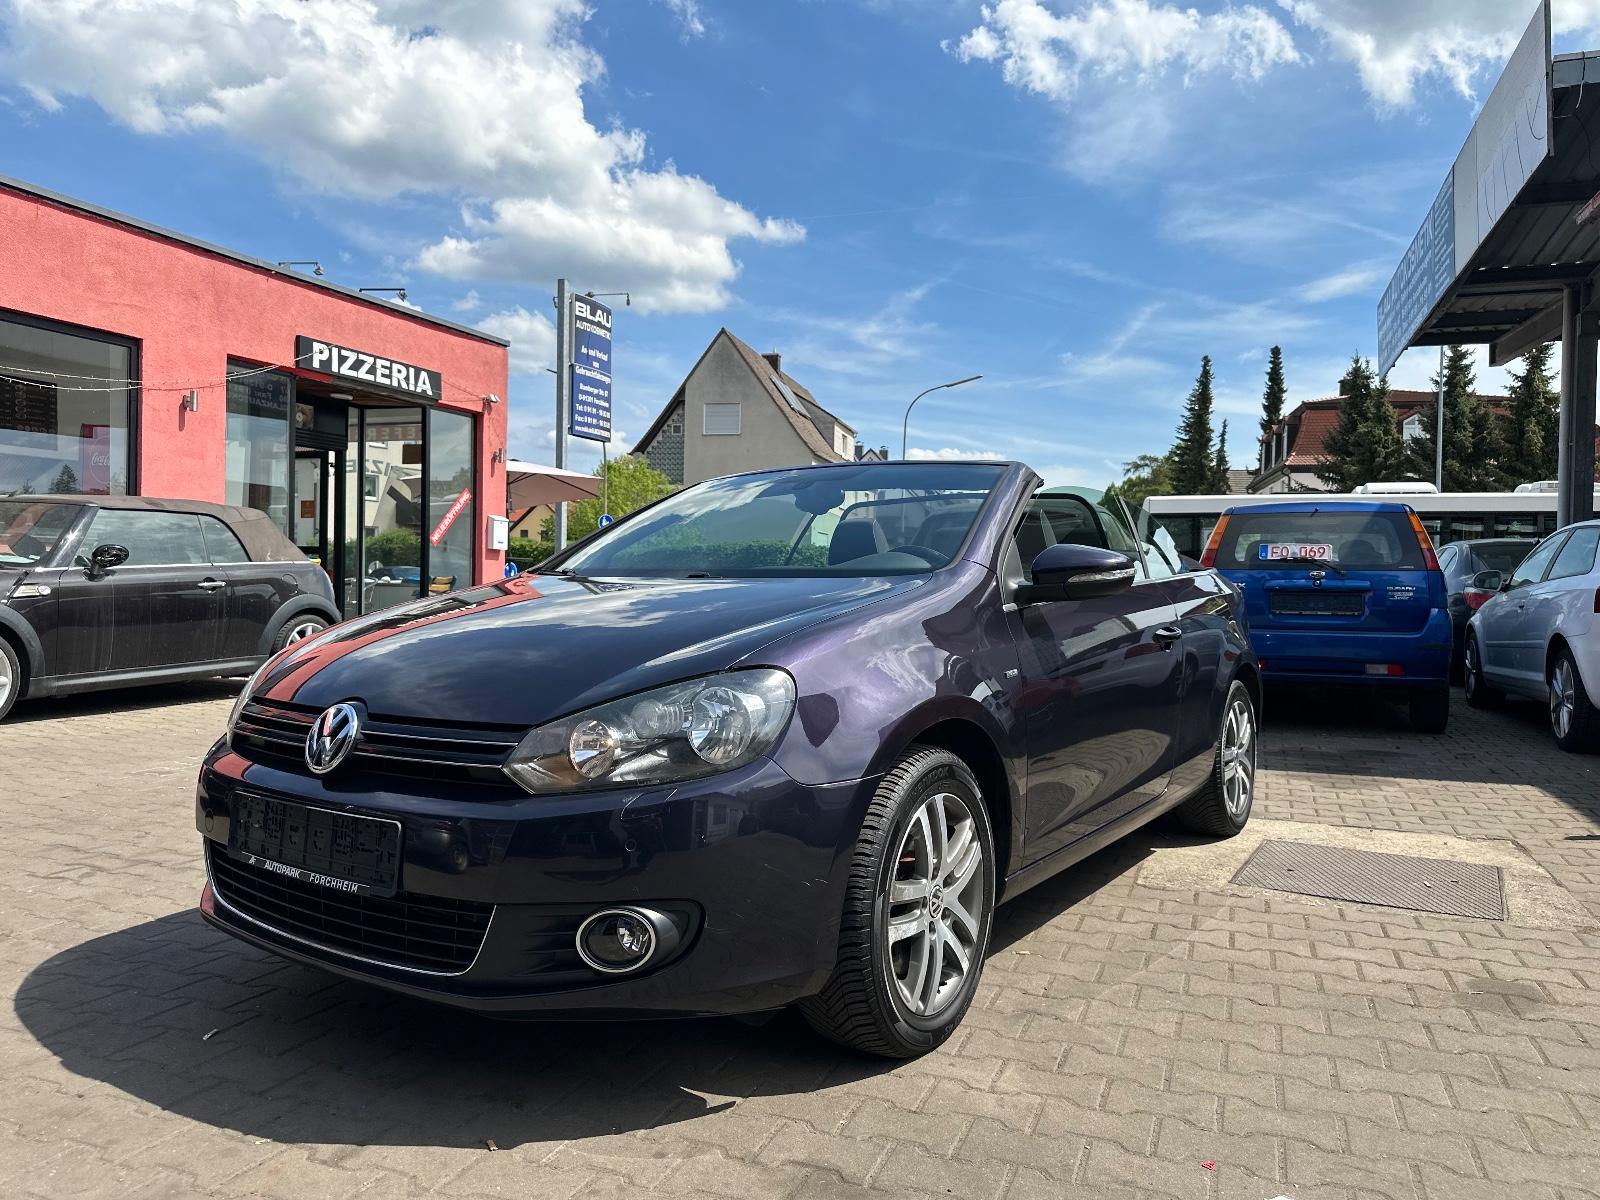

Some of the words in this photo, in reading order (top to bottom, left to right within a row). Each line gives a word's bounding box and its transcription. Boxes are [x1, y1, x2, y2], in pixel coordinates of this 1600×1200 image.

[575, 301, 611, 328] BLAU
[312, 341, 433, 395] PIZZERIA
[264, 859, 300, 879] AUTOPARK
[310, 873, 358, 893] FORCHHEIM
